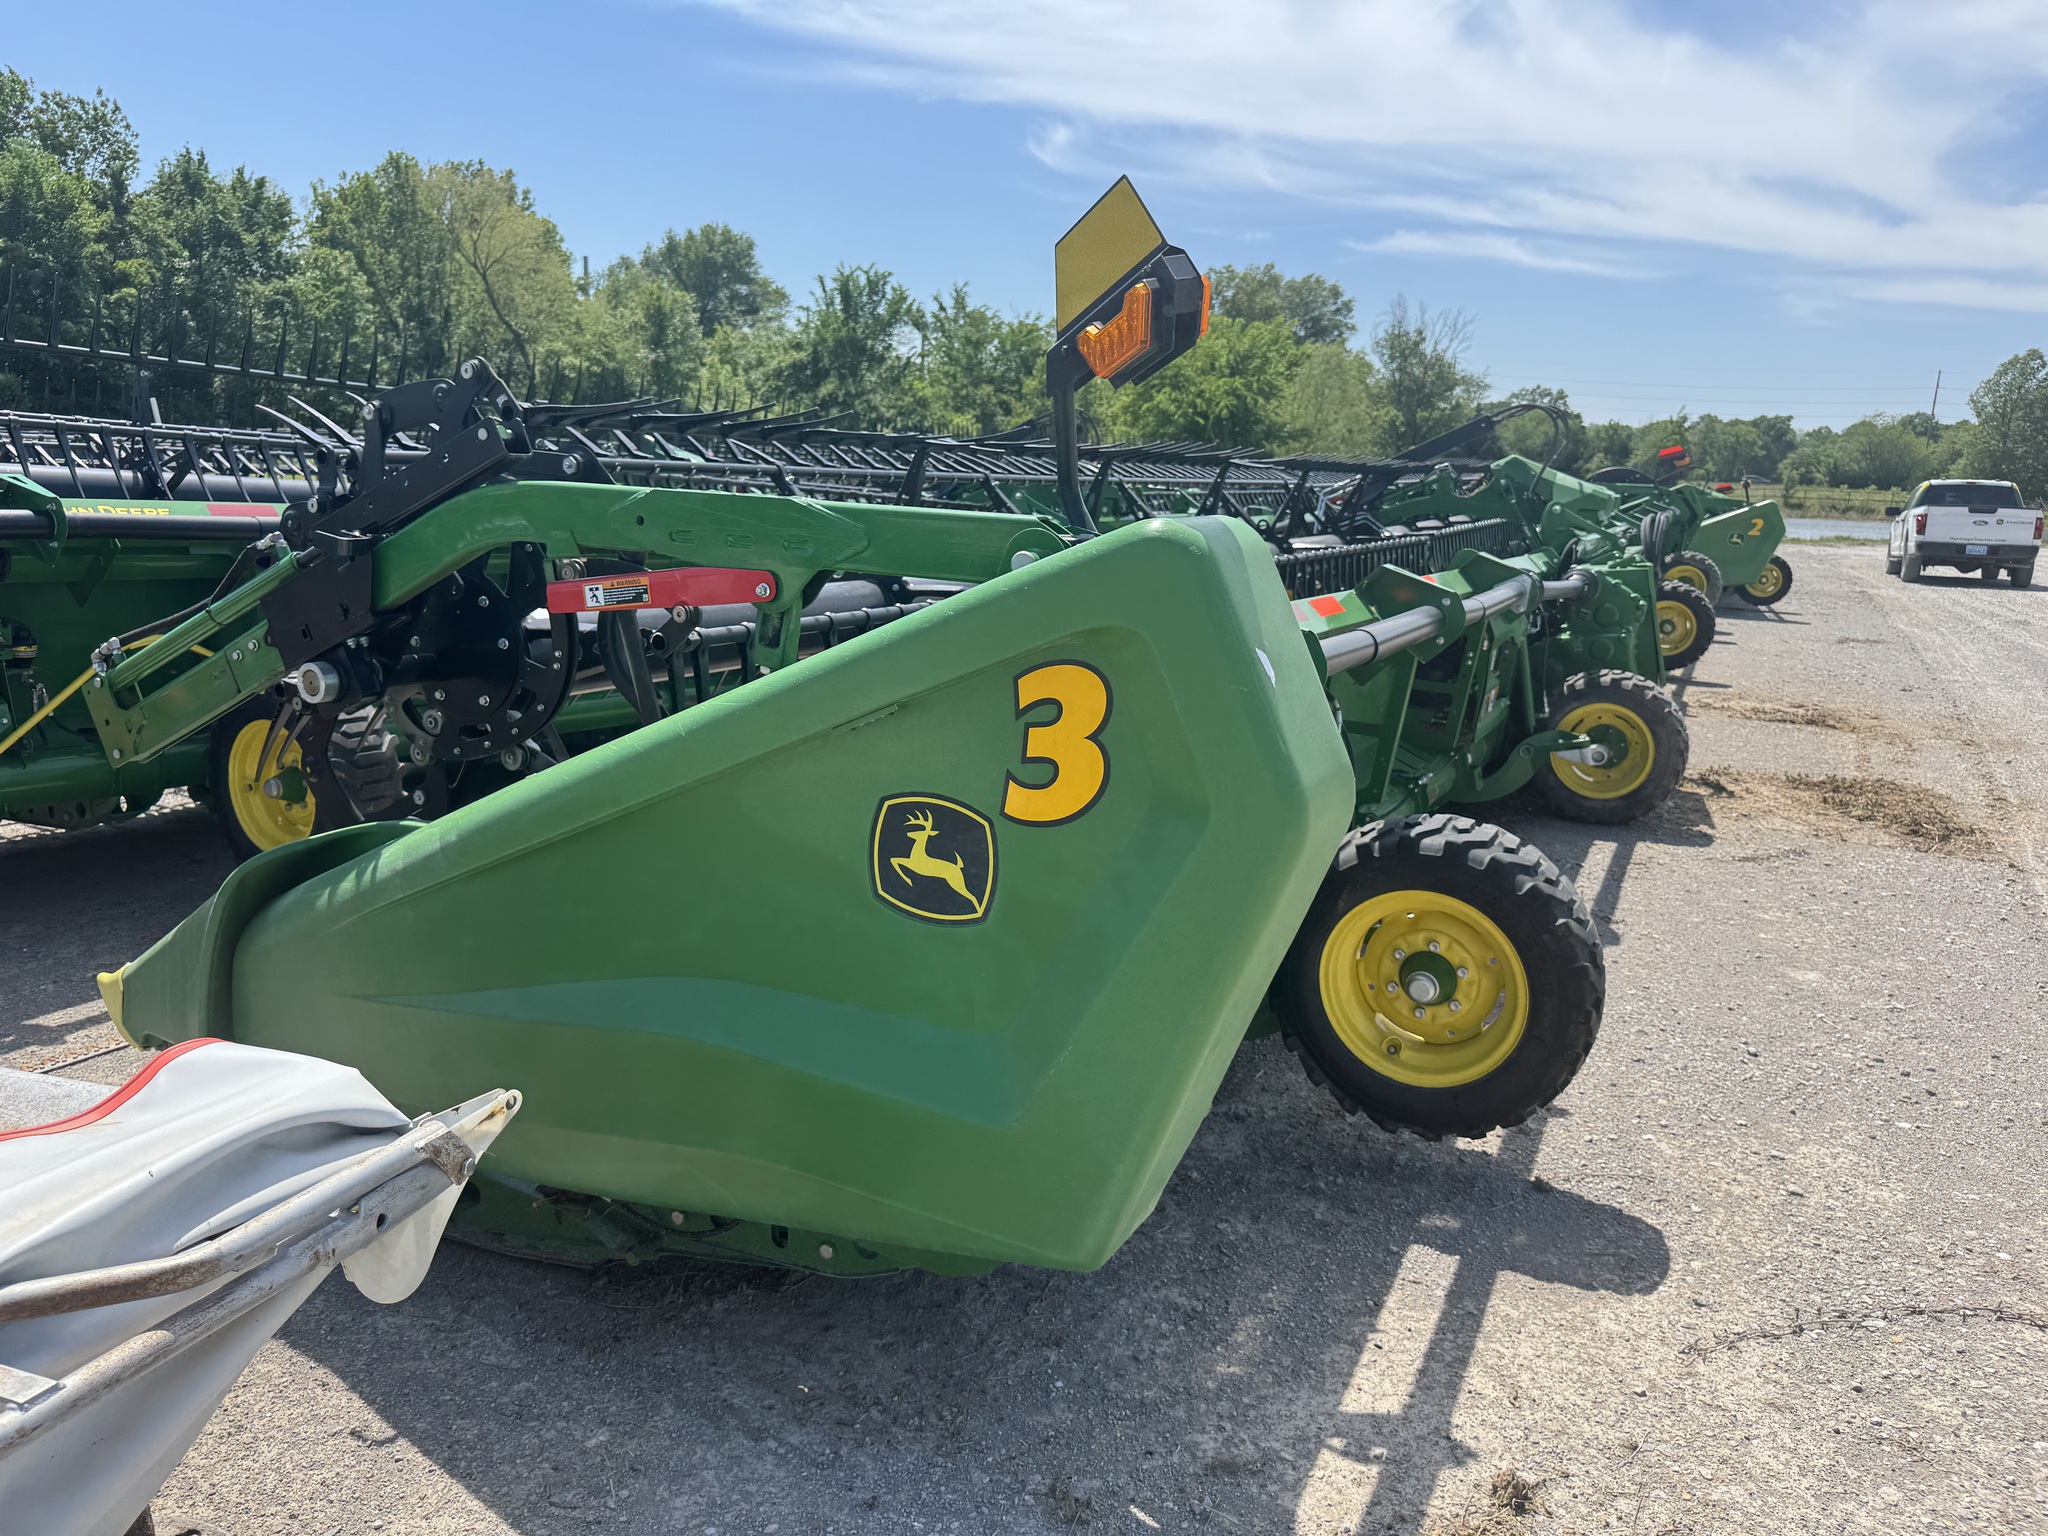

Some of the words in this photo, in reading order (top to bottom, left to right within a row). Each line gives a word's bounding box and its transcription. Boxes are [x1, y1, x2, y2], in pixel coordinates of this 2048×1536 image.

[1747, 518, 1764, 536] 2
[616, 578, 641, 586] WARNING
[999, 658, 1114, 828] 3
[1470, 884, 1554, 999] CARLSTAR
